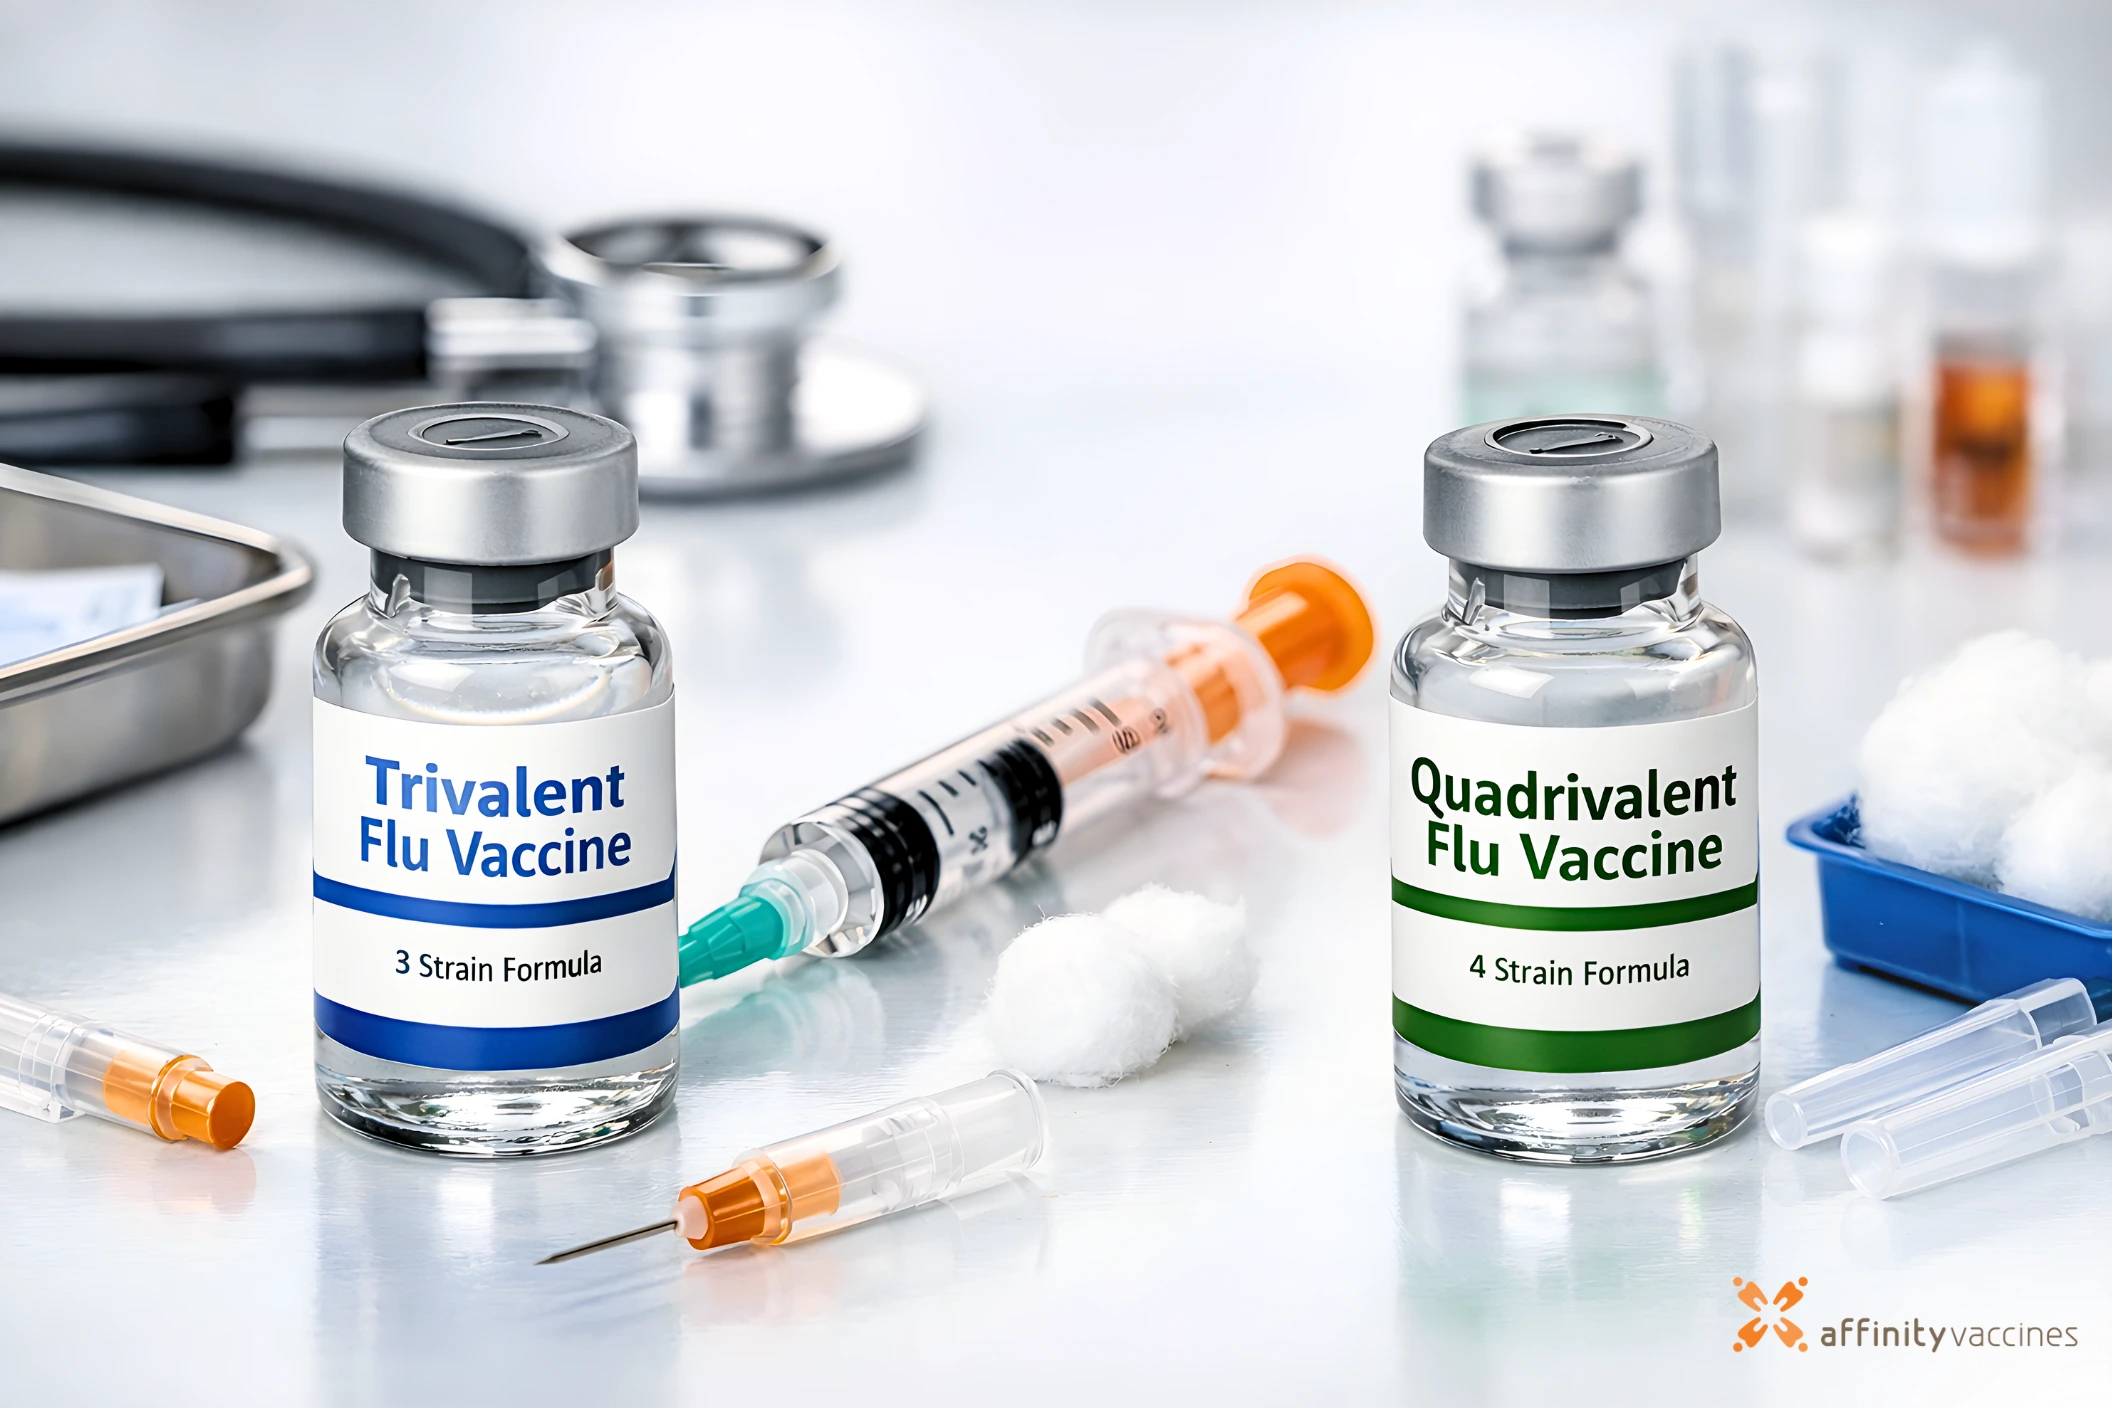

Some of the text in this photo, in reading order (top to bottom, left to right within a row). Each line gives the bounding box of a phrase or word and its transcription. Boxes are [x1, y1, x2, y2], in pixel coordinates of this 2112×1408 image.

[364, 754, 626, 819] Trivalent
[1410, 756, 1738, 820] Quadrivalent
[360, 815, 632, 878] Flu Vaccine
[1427, 819, 1724, 882] Flu Vaccine
[395, 949, 603, 983] 3 Strain Formula
[1469, 952, 1690, 986] 4 Strain Formula
